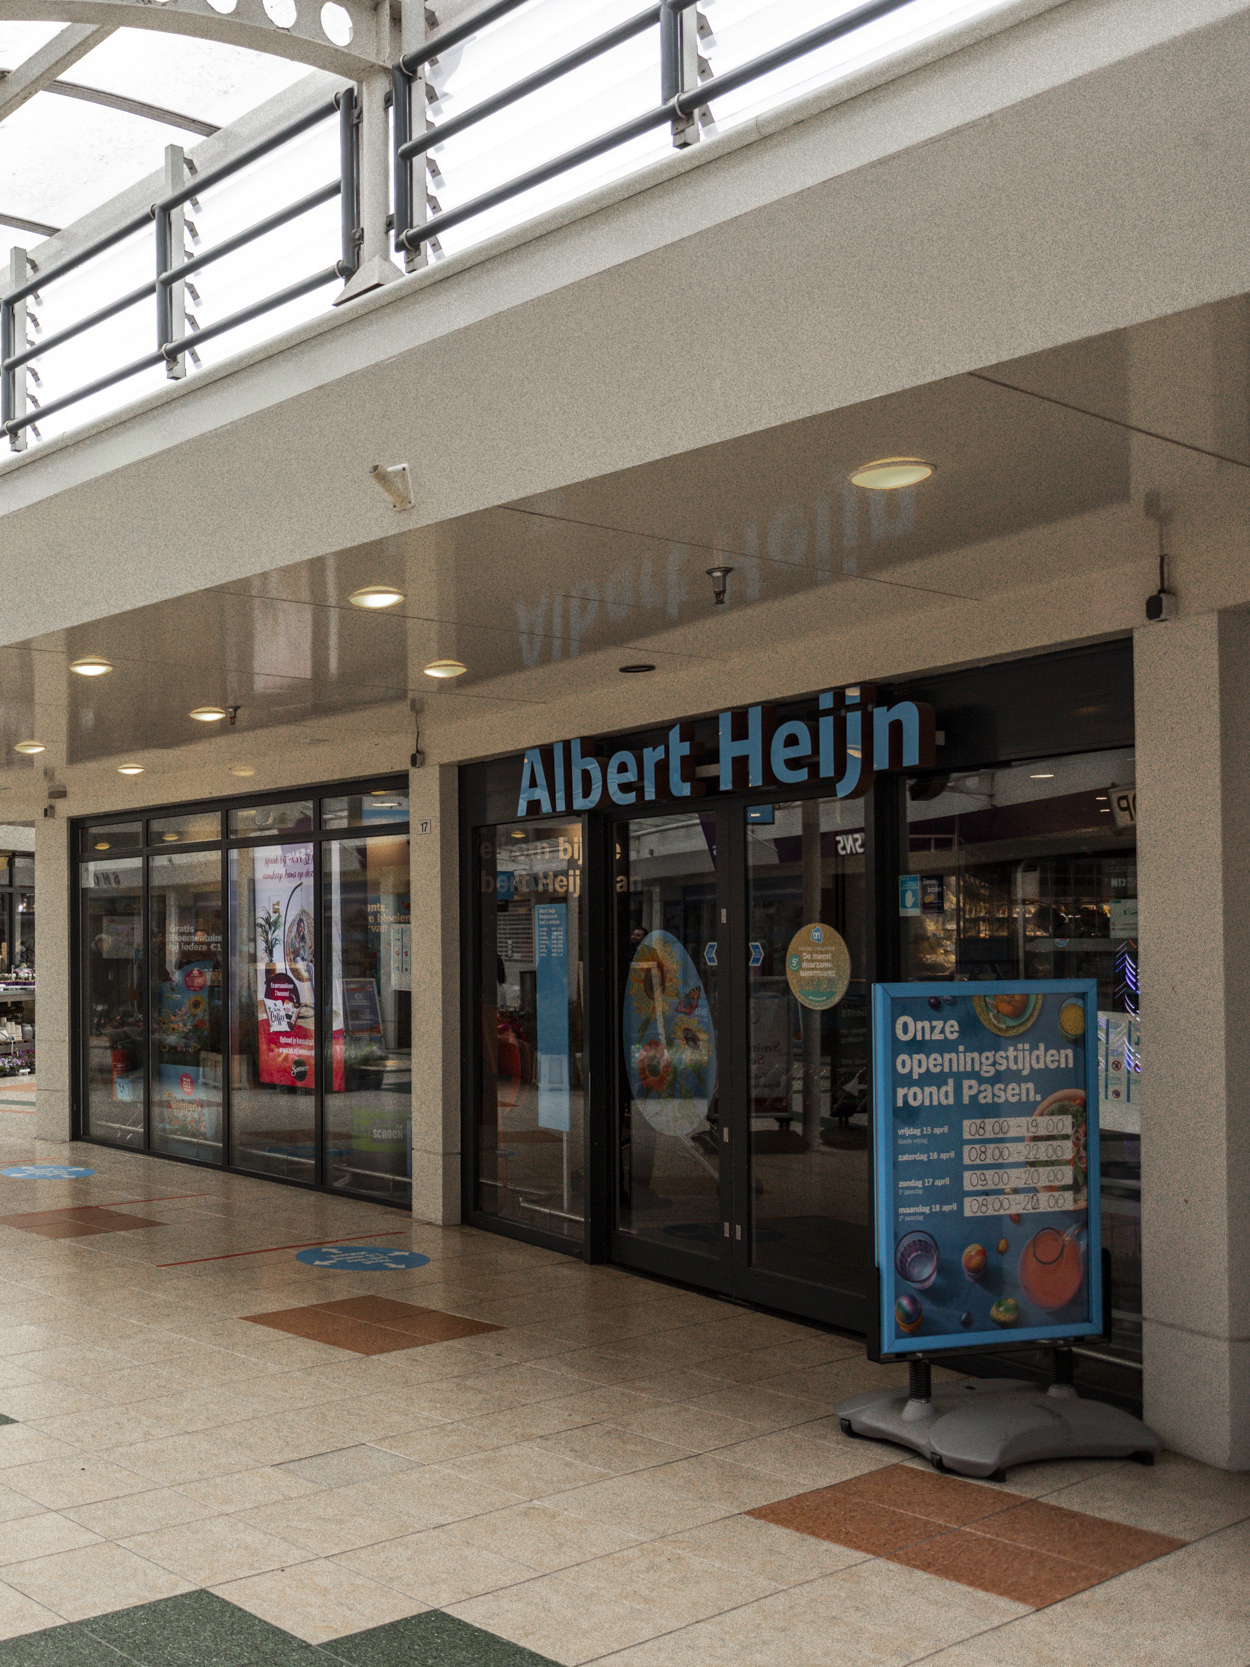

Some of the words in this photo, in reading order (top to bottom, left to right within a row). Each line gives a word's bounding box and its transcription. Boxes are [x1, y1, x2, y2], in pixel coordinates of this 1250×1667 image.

[517, 722, 691, 817] Albert
[718, 686, 920, 799] Heijn
[420, 821, 428, 832] 17
[812, 952, 832, 960] meest
[895, 1014, 959, 1042] Onze
[896, 1042, 1074, 1079] openingstijden
[896, 1078, 955, 1107] rond
[962, 1078, 1041, 1105] Pasen.
[897, 1126, 921, 1136] vrijdag
[922, 1126, 931, 1134] 15
[933, 1125, 949, 1135] april
[898, 1152, 928, 1162] zaterdag
[929, 1152, 938, 1160] 16
[939, 1150, 955, 1160] april
[898, 1179, 923, 1188] zondag
[924, 1178, 933, 1186] 17
[934, 1177, 950, 1187] april
[898, 1205, 930, 1214] maandag
[931, 1204, 940, 1212] 18
[941, 1203, 957, 1213] april
